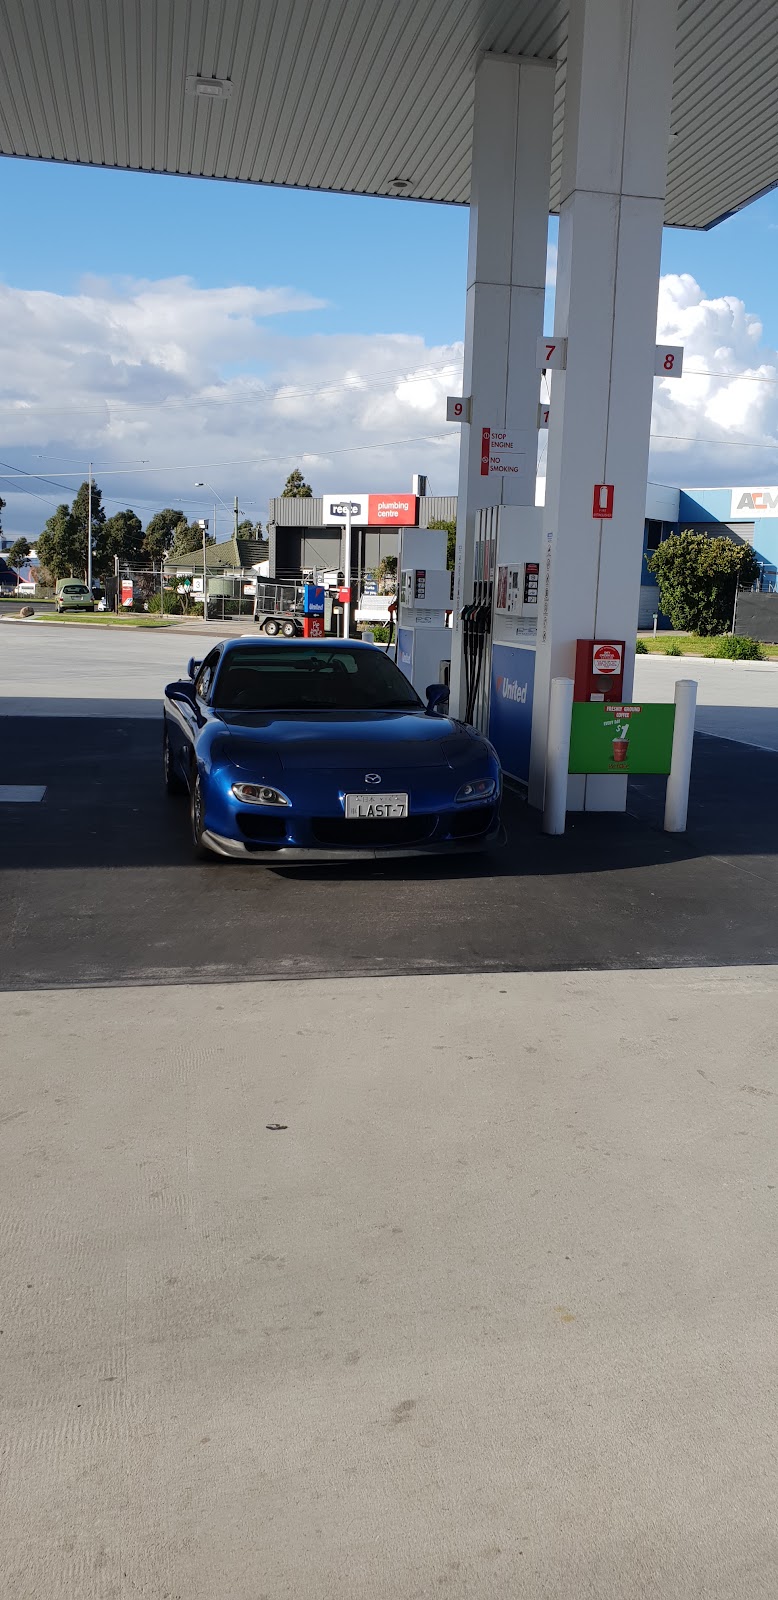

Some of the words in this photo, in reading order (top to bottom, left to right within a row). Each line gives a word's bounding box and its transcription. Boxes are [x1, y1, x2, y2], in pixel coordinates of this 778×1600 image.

[545, 345, 556, 361] 7
[663, 354, 675, 370] 8
[454, 403, 463, 416] 9
[332, 506, 359, 514] reee
[377, 501, 409, 511] plumbing
[308, 603, 324, 611] United
[502, 677, 528, 704] United
[615, 723, 630, 739] $1
[358, 804, 405, 817] LAST-7
